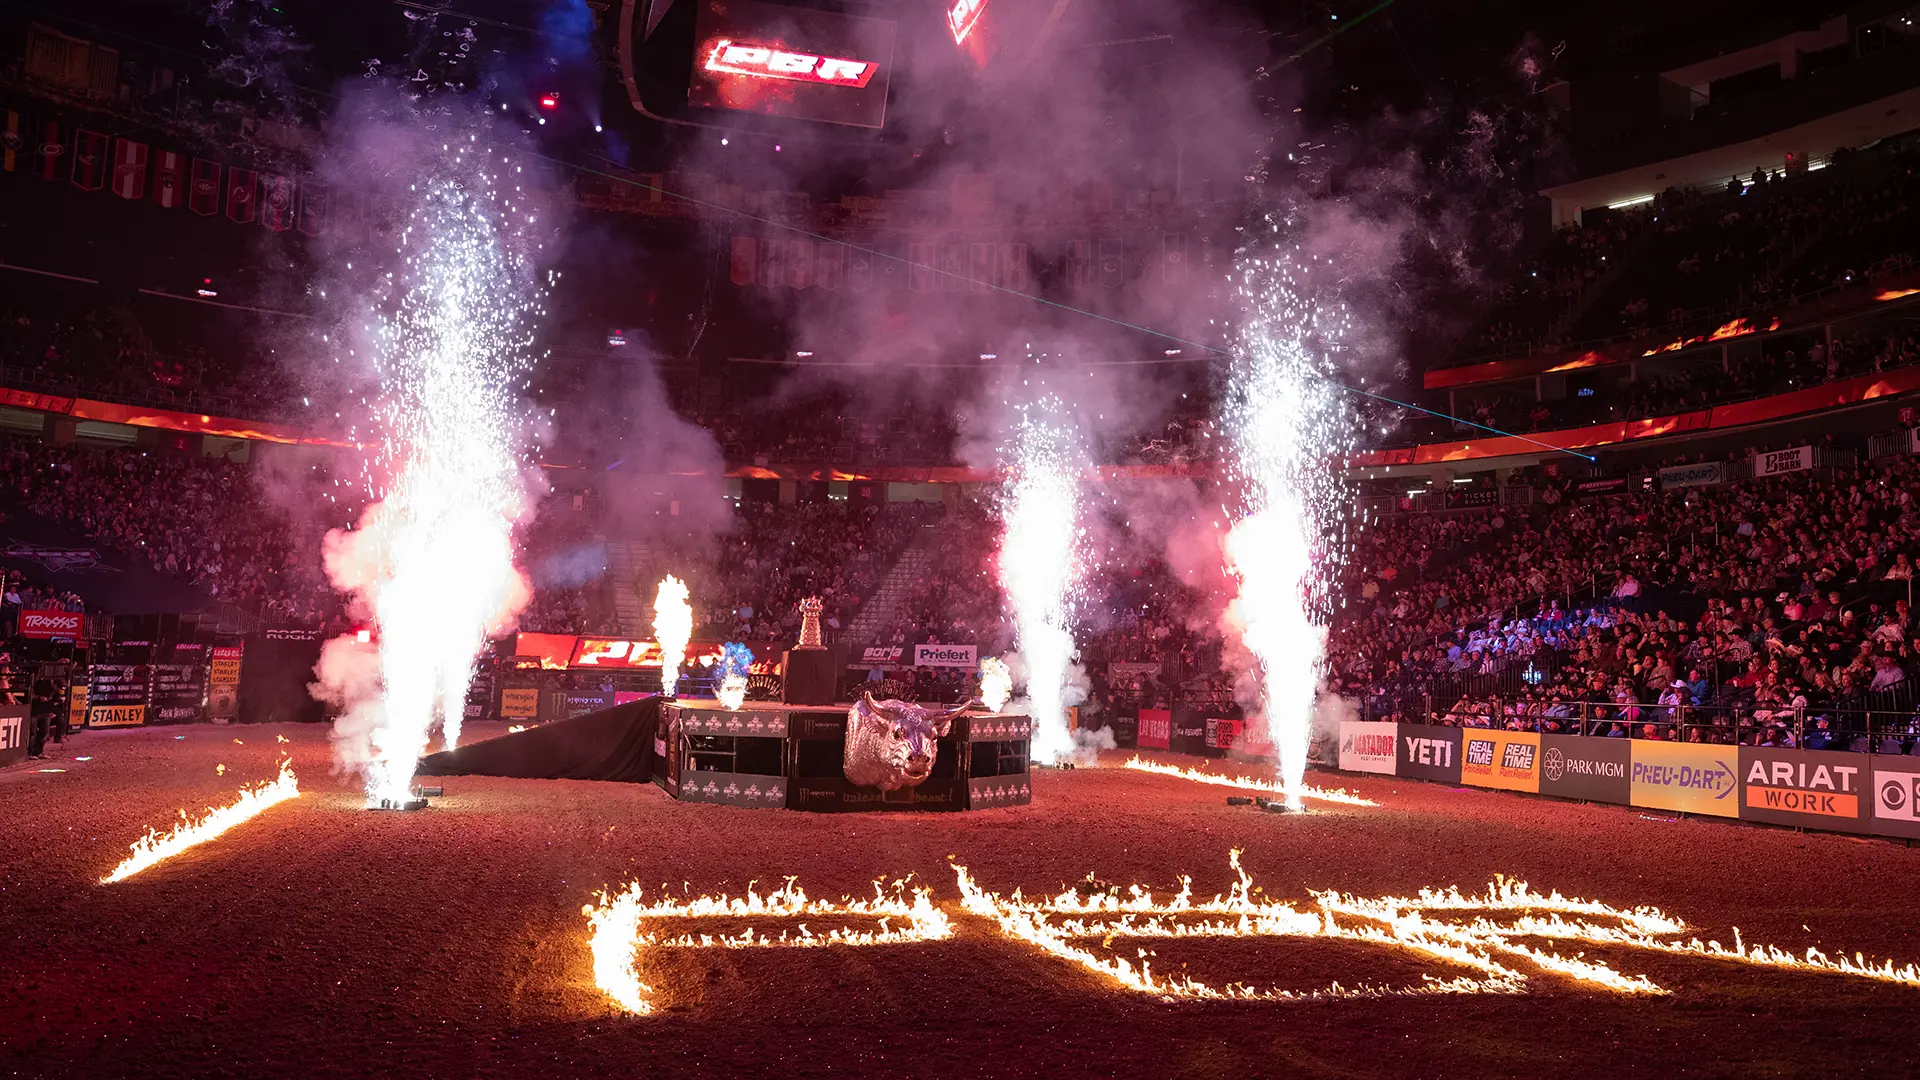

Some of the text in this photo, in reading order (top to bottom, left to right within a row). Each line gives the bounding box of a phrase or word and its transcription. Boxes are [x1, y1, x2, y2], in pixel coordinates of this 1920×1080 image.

[721, 46, 868, 80] PBR
[1779, 450, 1800, 461] BOOT
[1779, 459, 1800, 471] BARN
[1661, 469, 1715, 482] PNEU-DART
[1464, 491, 1498, 500] TICKET
[24, 615, 79, 629] TRAXXAS
[920, 648, 970, 660] Priefert
[91, 708, 143, 723] STANLEY
[1354, 734, 1395, 757] MATADOR
[1405, 736, 1453, 769] YETI
[1469, 741, 1493, 753] REAL
[1505, 743, 1533, 757] REAL
[1468, 751, 1492, 765] TIME
[1504, 755, 1532, 769] TIME
[1567, 759, 1624, 778] PARK MGM
[1632, 762, 1726, 791] PNEU-DART
[1747, 760, 1858, 792] ARIAT
[1765, 790, 1837, 813] WORK
